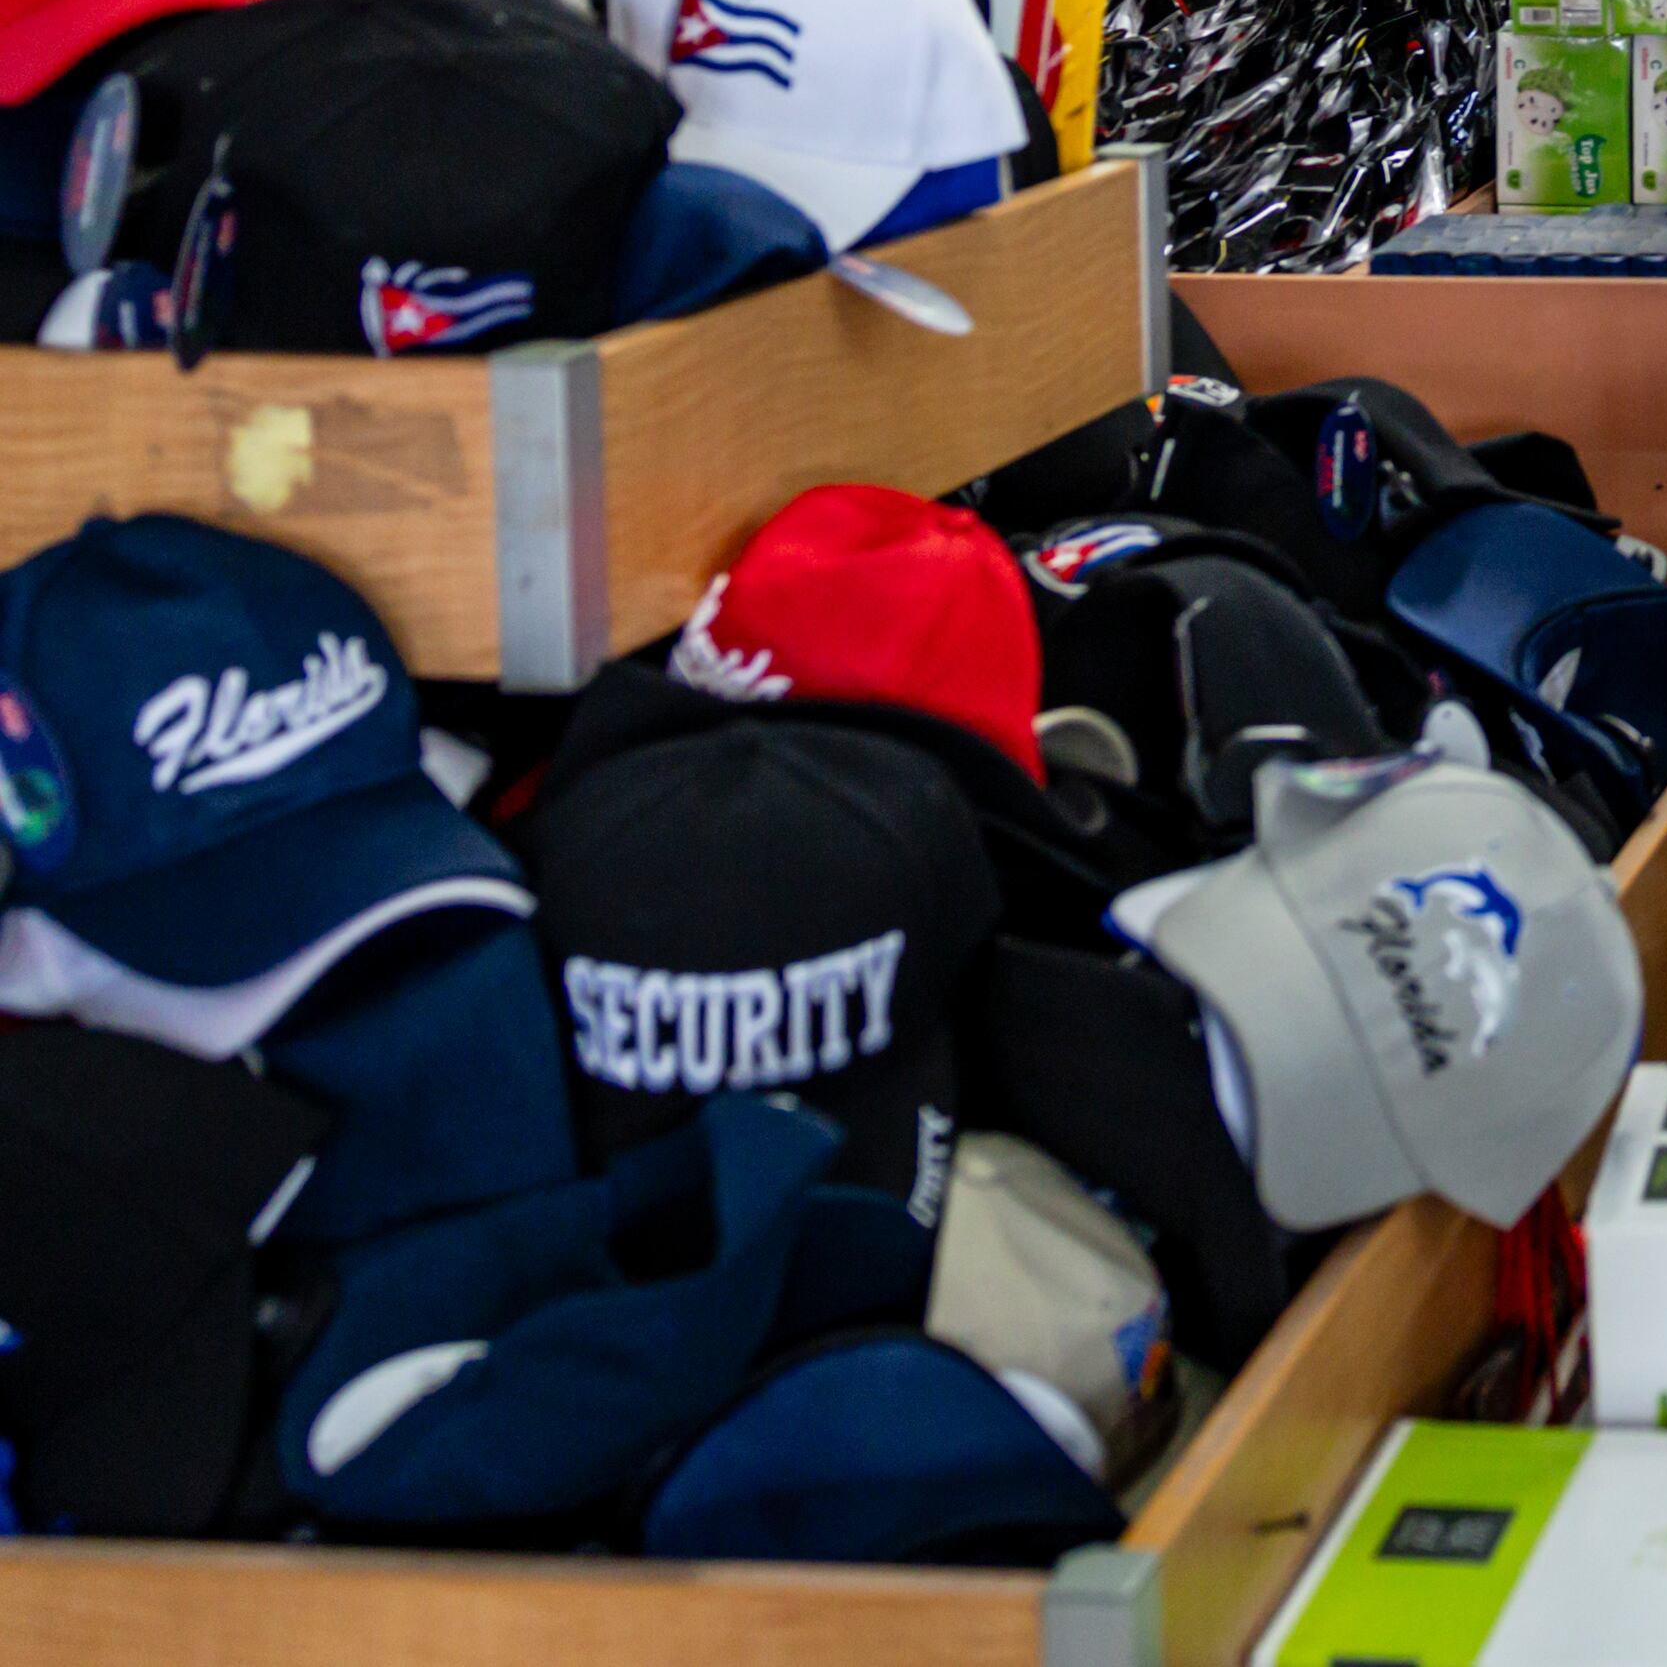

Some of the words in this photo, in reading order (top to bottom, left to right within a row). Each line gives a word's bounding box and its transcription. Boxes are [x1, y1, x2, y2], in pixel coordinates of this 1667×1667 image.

[1577, 138, 1597, 165] Top
[133, 631, 389, 798] Florida
[562, 929, 906, 1095] SECURITY
[1334, 892, 1456, 1079] Florida
